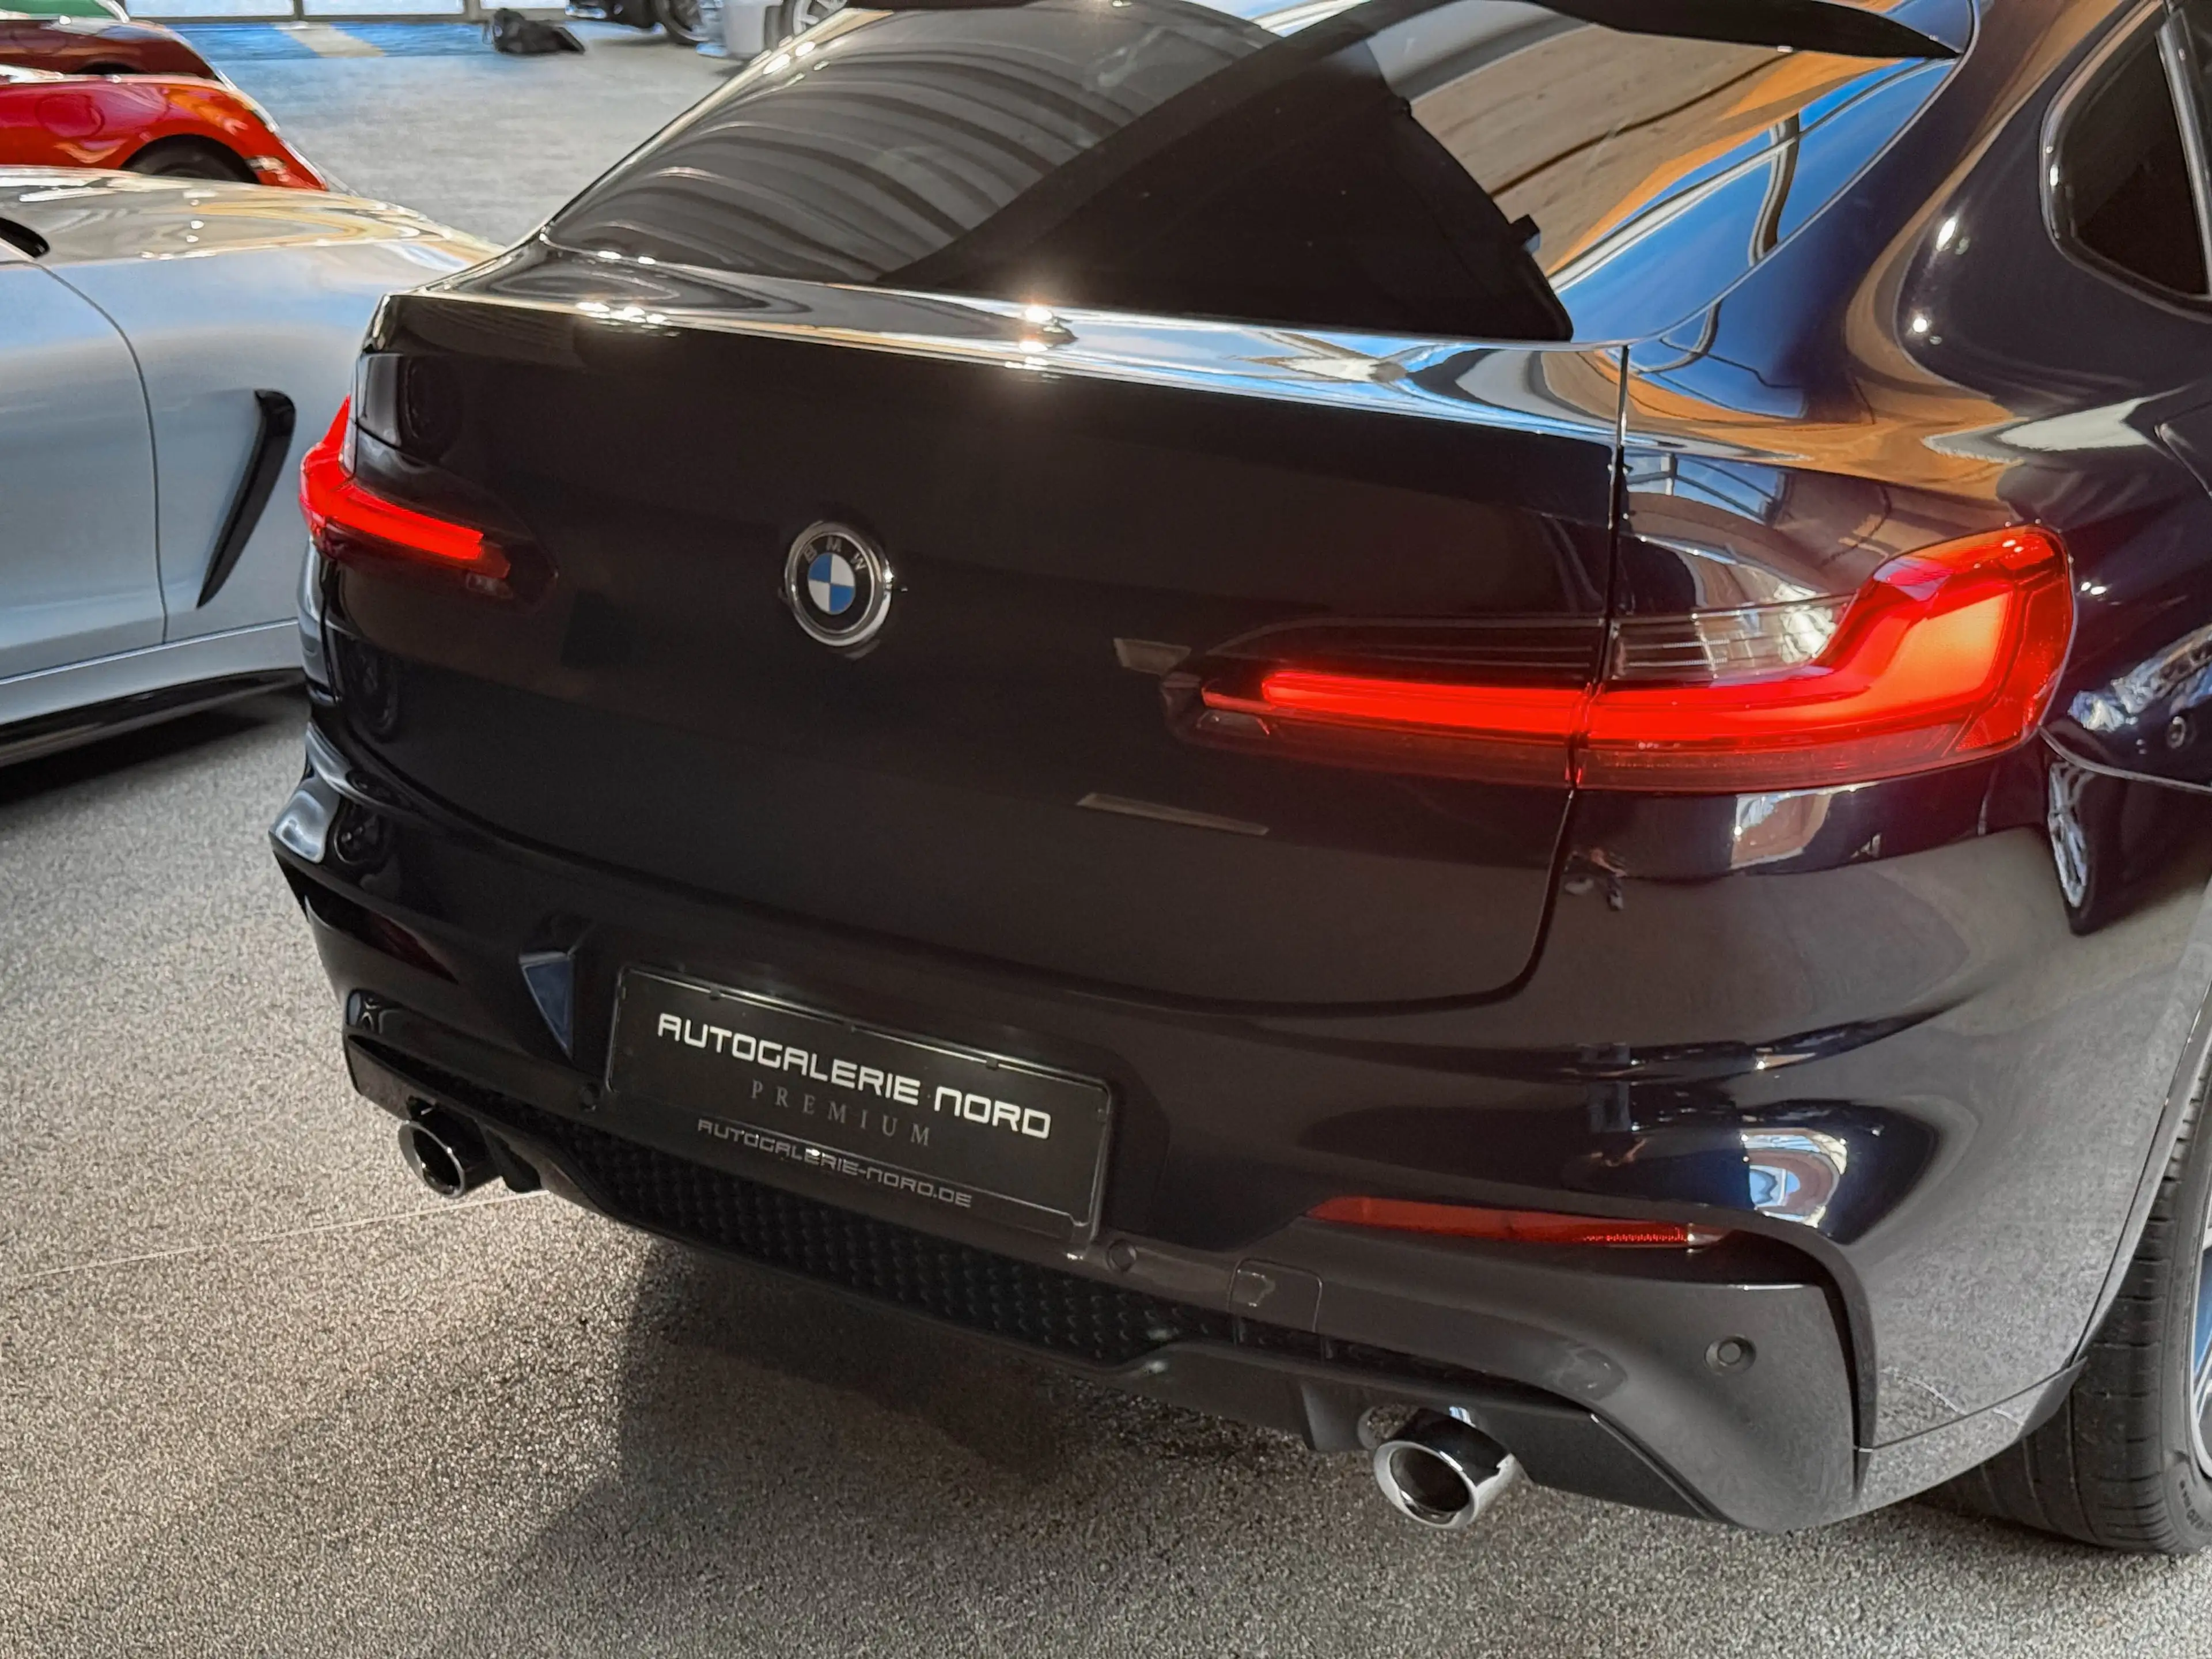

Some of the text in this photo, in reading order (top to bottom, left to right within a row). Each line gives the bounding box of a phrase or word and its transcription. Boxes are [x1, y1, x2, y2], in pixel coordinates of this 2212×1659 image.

[804, 536, 866, 571] BMW
[657, 1012, 1051, 1139] AUTOGALERIE NORD
[751, 1078, 930, 1147] PREMIUM
[698, 1118, 972, 1208] AUTOGALERIE-NORD.DE
